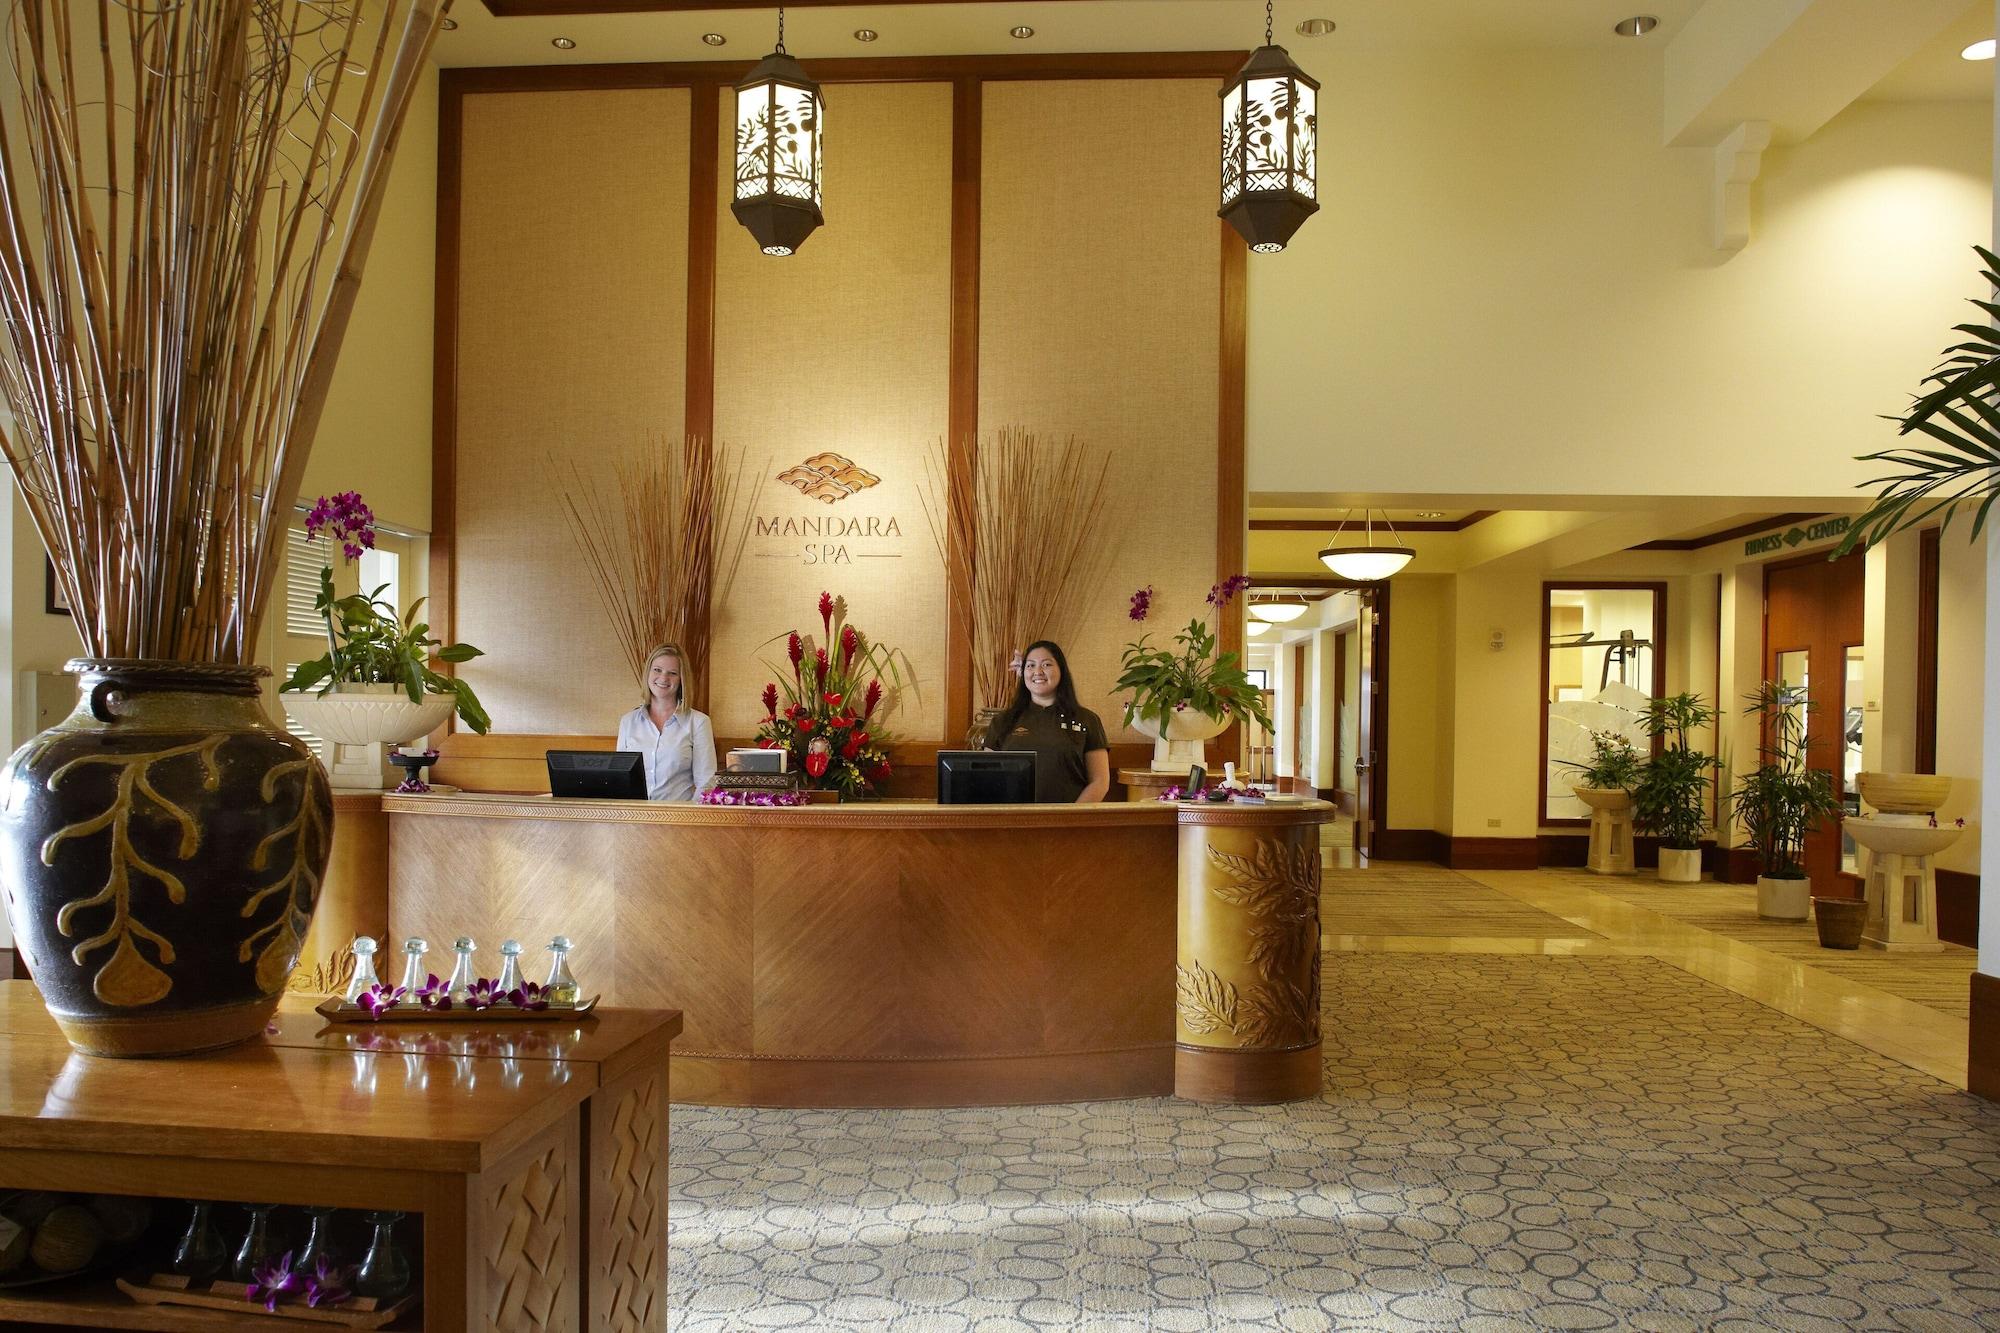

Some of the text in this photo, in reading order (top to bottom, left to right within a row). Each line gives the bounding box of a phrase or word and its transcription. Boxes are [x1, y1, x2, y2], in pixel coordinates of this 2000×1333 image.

[754, 516, 903, 537] MANDARA
[1745, 516, 1850, 556] FITNESS CENTER
[803, 544, 852, 565] SPA
